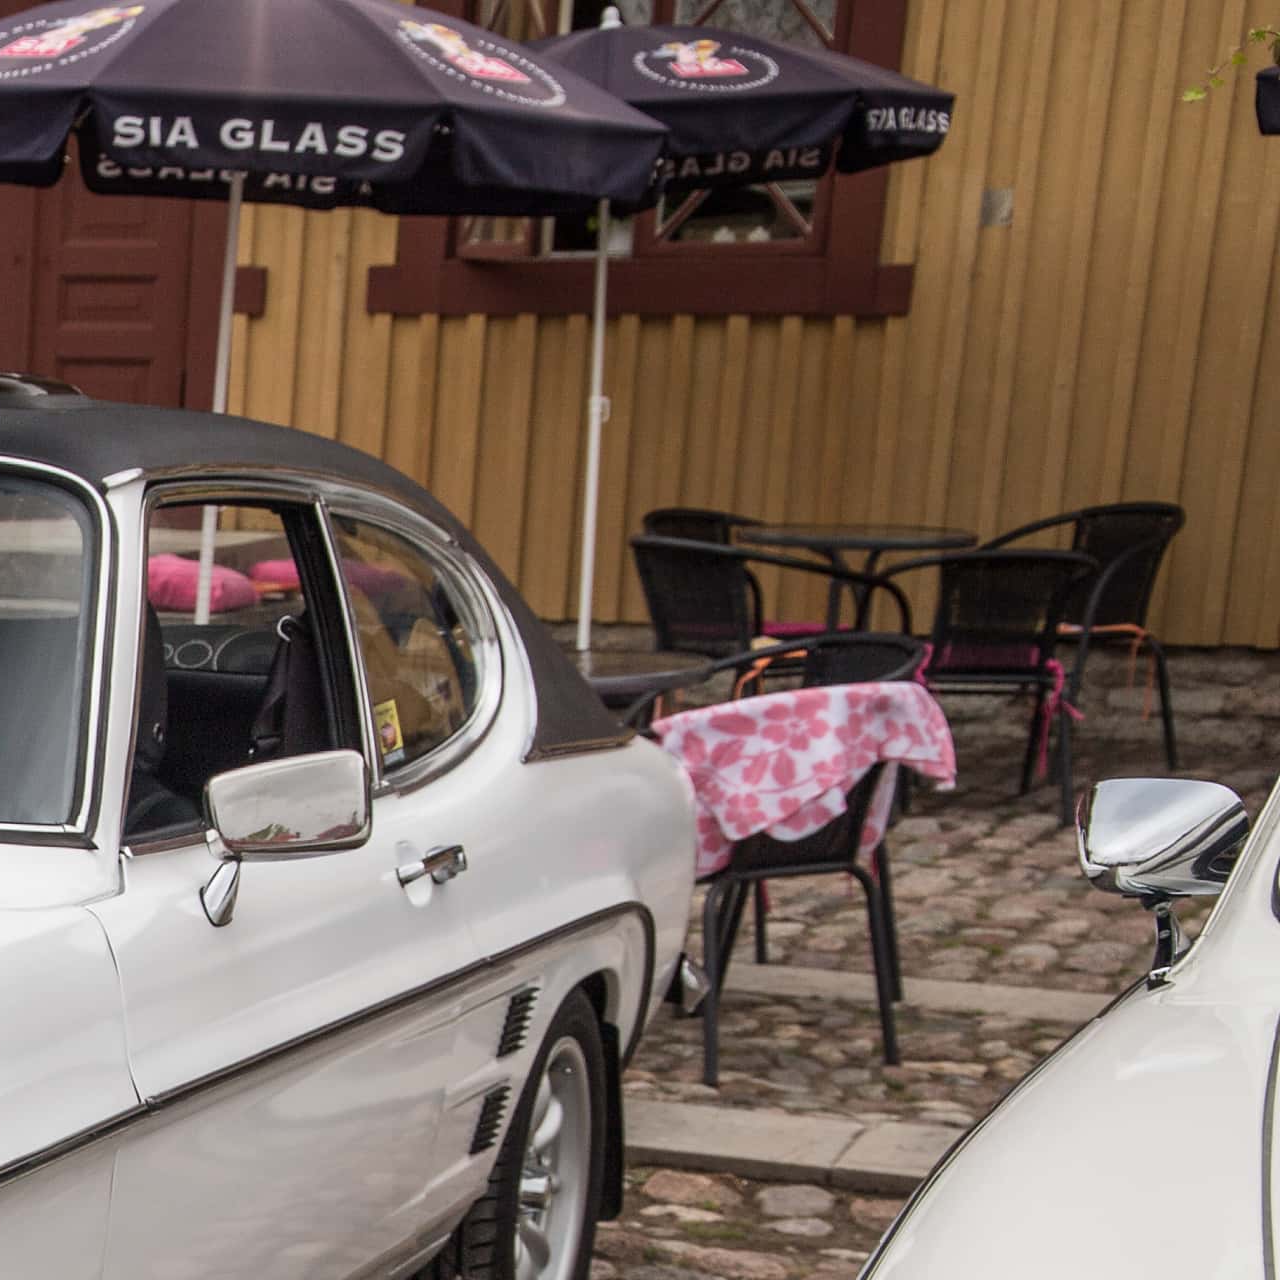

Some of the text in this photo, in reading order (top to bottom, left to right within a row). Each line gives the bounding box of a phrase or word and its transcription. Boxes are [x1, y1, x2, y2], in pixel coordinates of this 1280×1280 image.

[112, 116, 406, 162] SIA GLASS
[898, 107, 950, 135] GLASS
